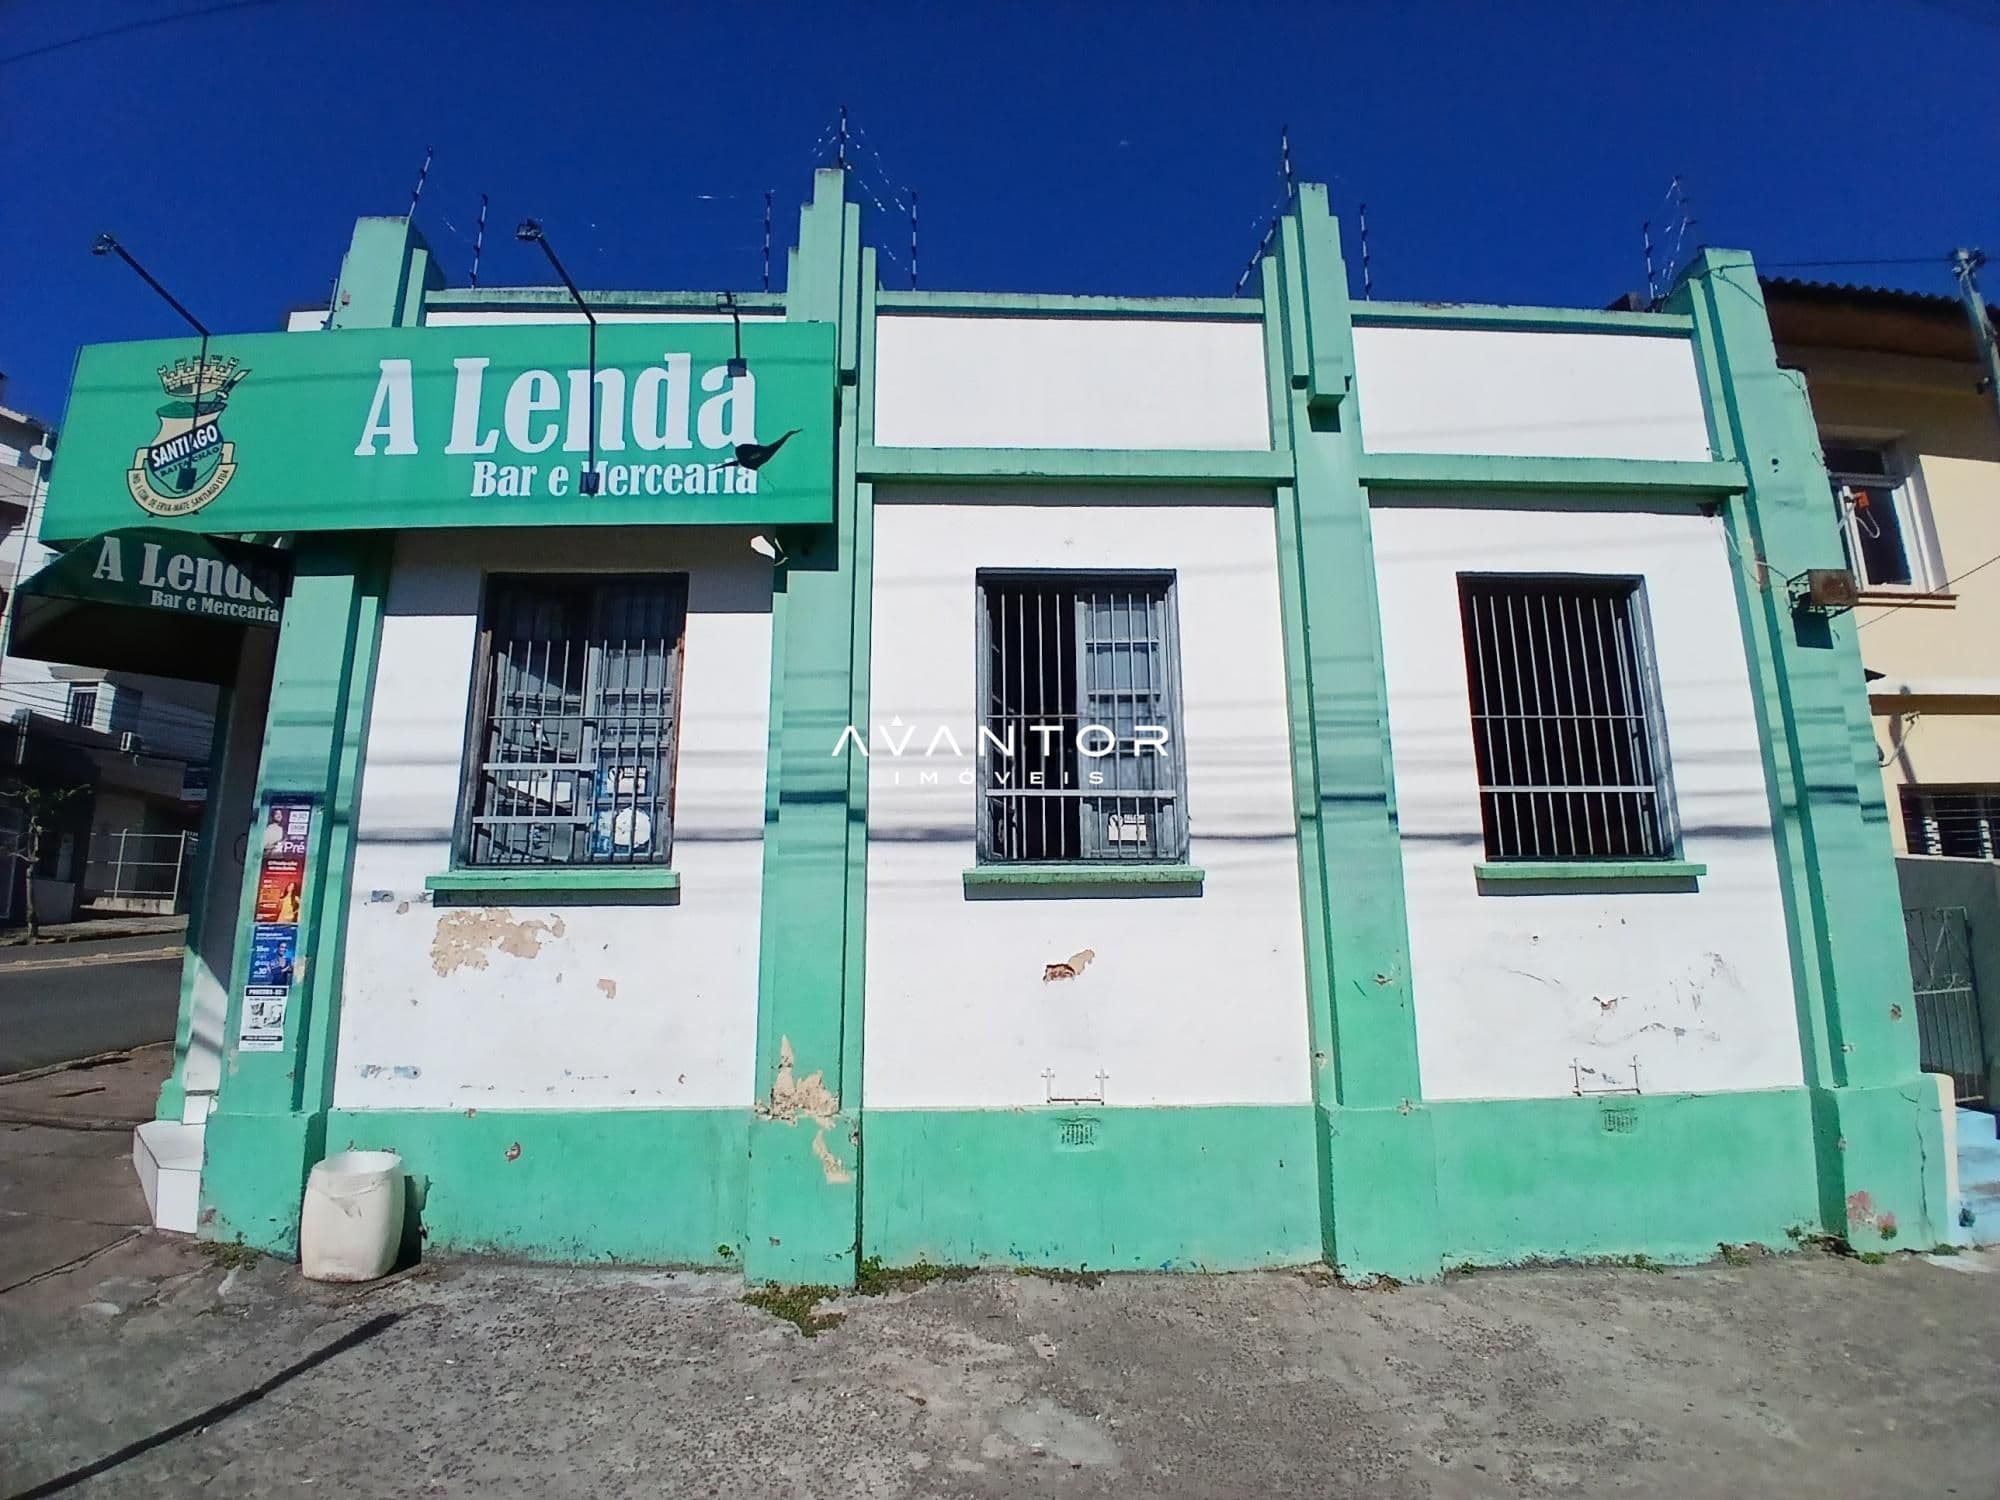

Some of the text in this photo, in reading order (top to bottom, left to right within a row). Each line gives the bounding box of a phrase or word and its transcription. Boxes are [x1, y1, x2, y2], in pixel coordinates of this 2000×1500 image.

[354, 352, 759, 456] A Lenda
[470, 460, 537, 497] Bar
[548, 463, 569, 495] e
[92, 536, 123, 582] A
[151, 590, 182, 609] Bar
[186, 597, 197, 611] e
